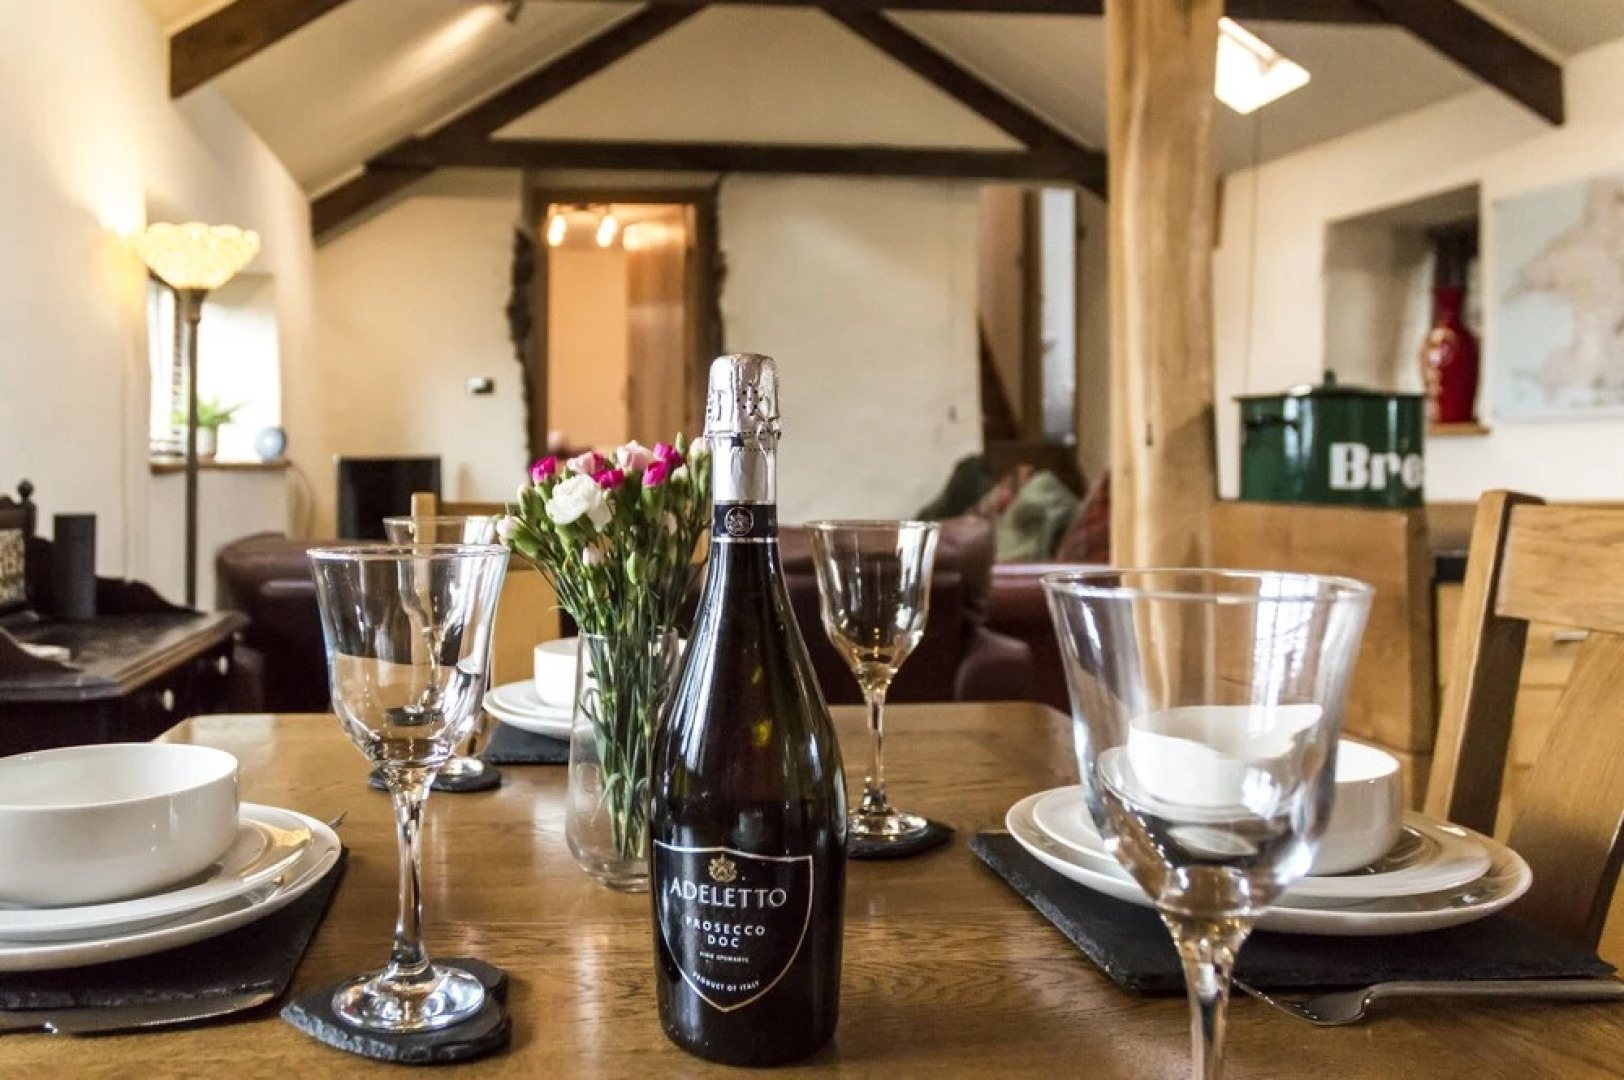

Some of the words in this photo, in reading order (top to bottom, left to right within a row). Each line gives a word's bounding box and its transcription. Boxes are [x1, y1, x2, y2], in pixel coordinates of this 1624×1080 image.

[670, 877, 787, 908] ADELETTO
[686, 915, 766, 936] PROSECCO
[707, 934, 740, 948] DOC
[693, 970, 725, 990] PRODUCT
[727, 984, 737, 992] OF
[739, 980, 760, 991] ITALY
